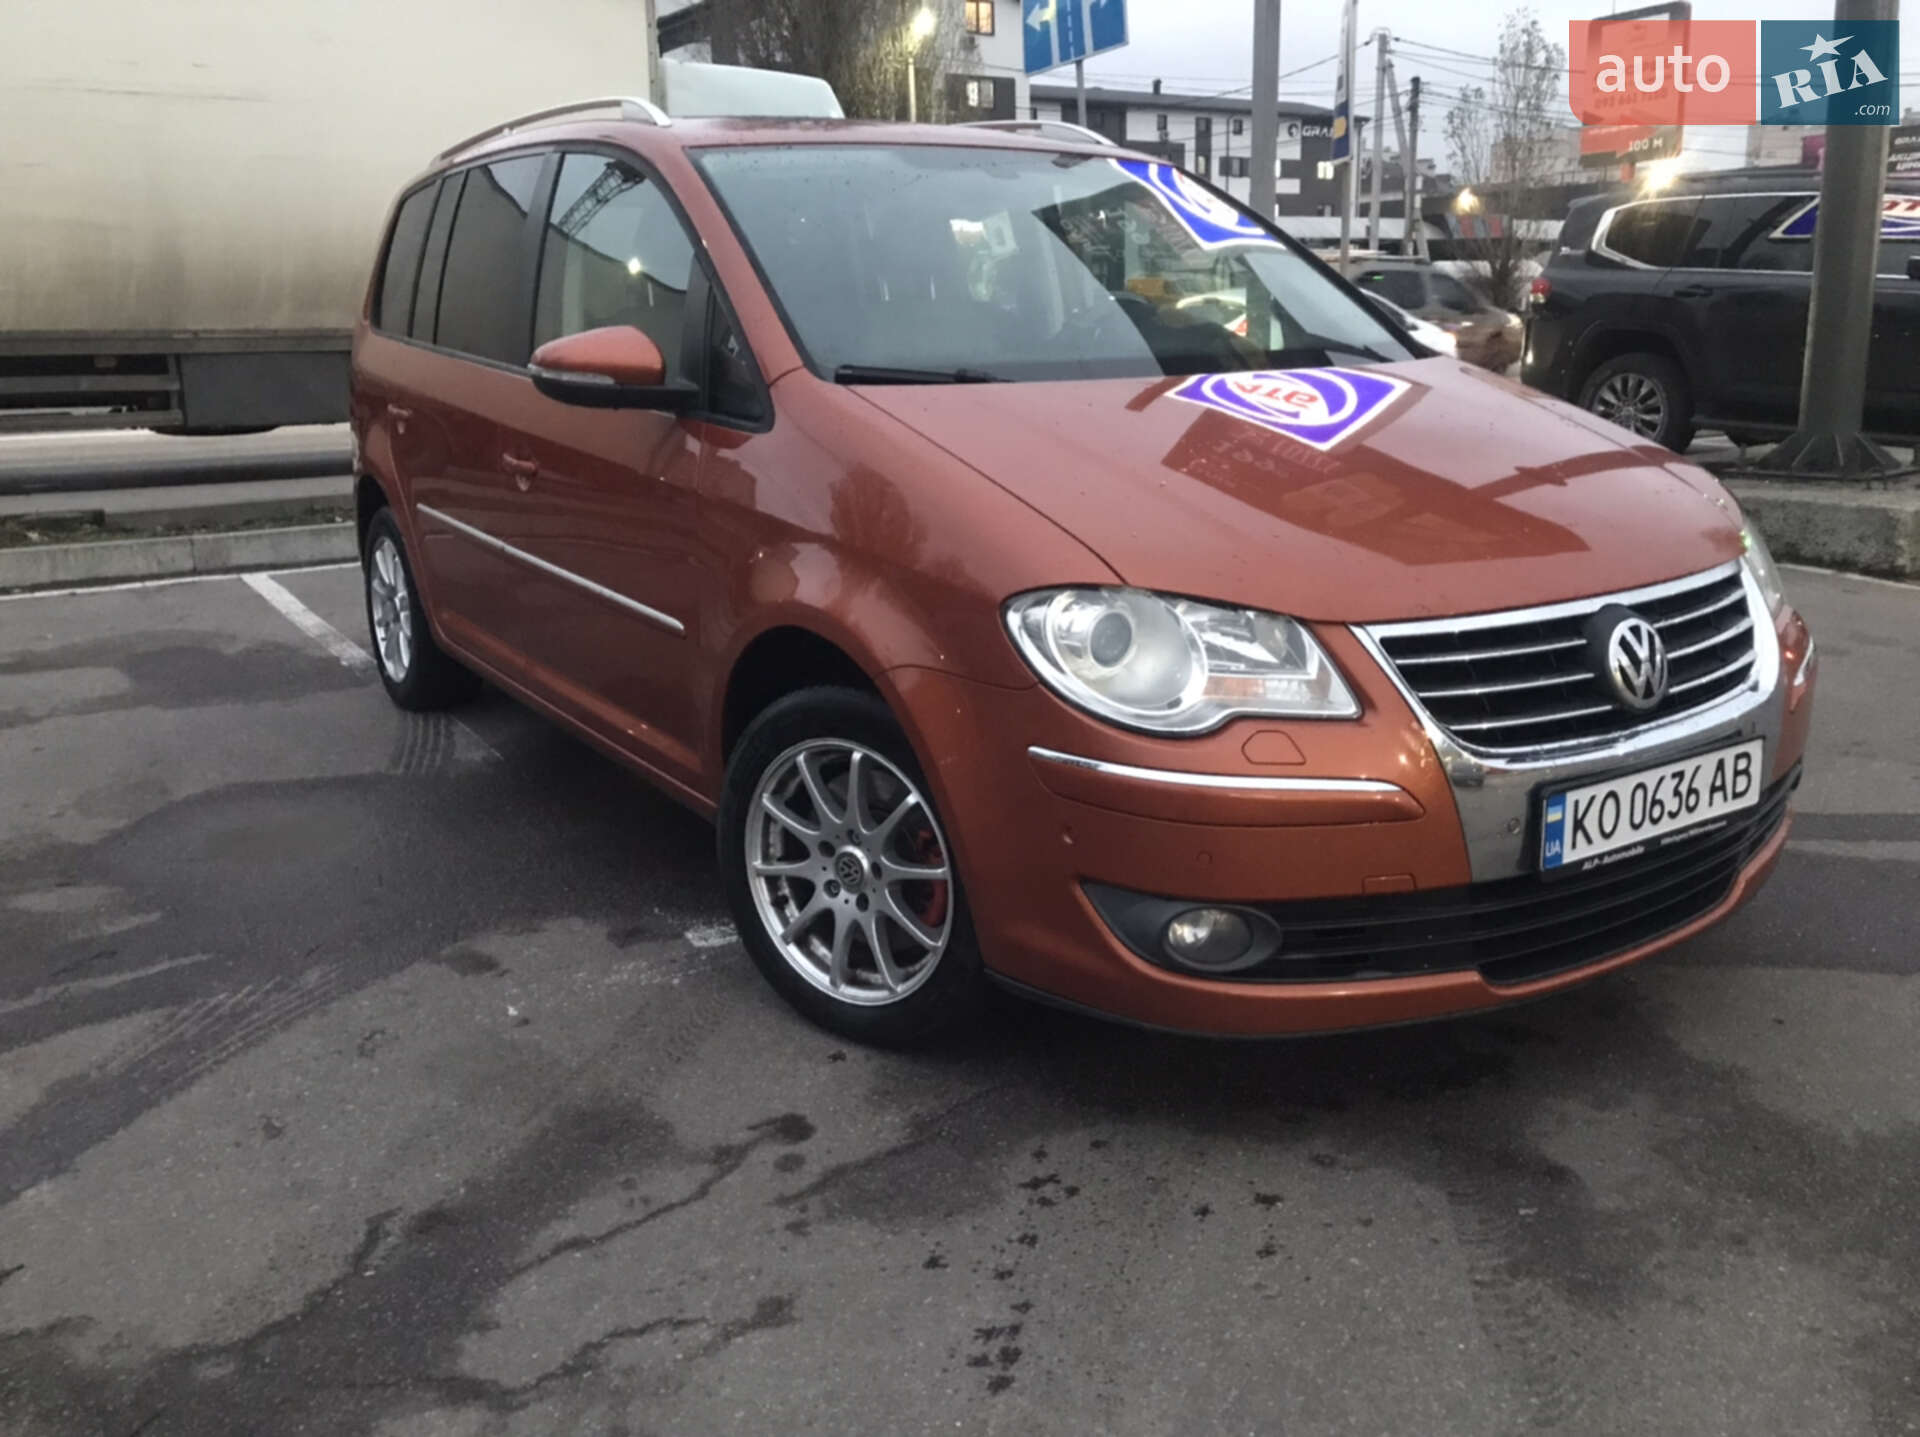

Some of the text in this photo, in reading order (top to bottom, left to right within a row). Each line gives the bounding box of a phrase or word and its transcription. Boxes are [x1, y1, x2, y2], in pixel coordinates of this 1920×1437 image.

[1571, 789, 1621, 850] KO
[1629, 764, 1702, 831] 0636
[1708, 751, 1752, 808] AB
[1546, 840, 1561, 857] UA
